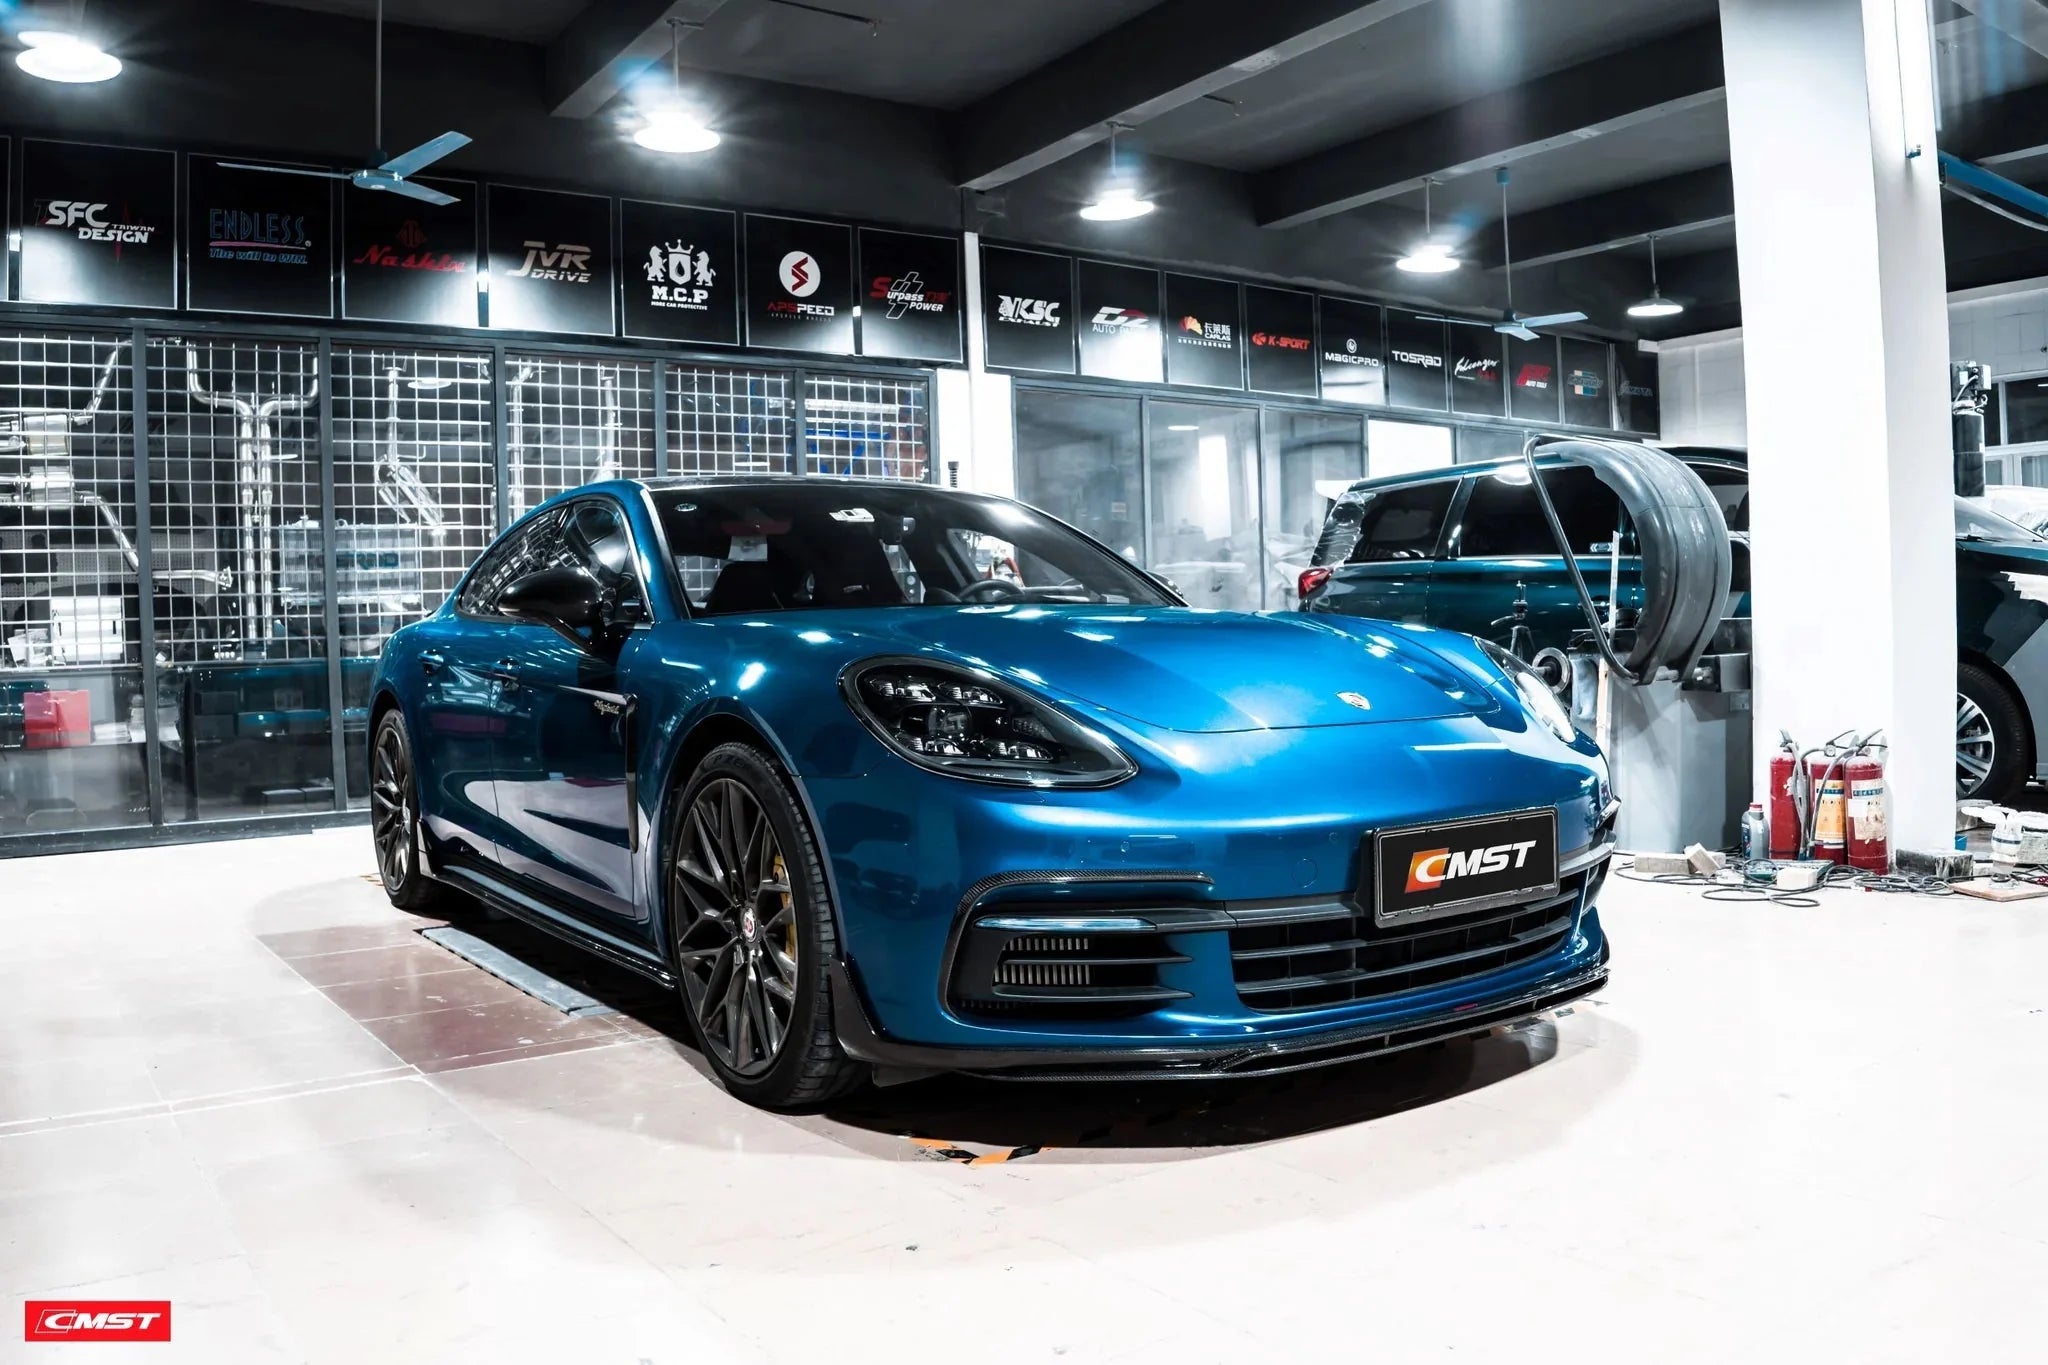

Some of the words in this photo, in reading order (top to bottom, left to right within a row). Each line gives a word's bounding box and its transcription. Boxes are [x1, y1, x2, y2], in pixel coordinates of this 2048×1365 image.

[45, 200, 110, 229] SFC
[78, 227, 149, 244] DESIGN
[111, 223, 155, 233] TAIWAN
[209, 207, 305, 245] ENDLESS
[504, 240, 592, 277] JVR
[651, 285, 709, 304] M.C.P
[909, 301, 943, 312] POWER
[1092, 323, 1116, 334] AUTO
[1415, 840, 1537, 883] CMST
